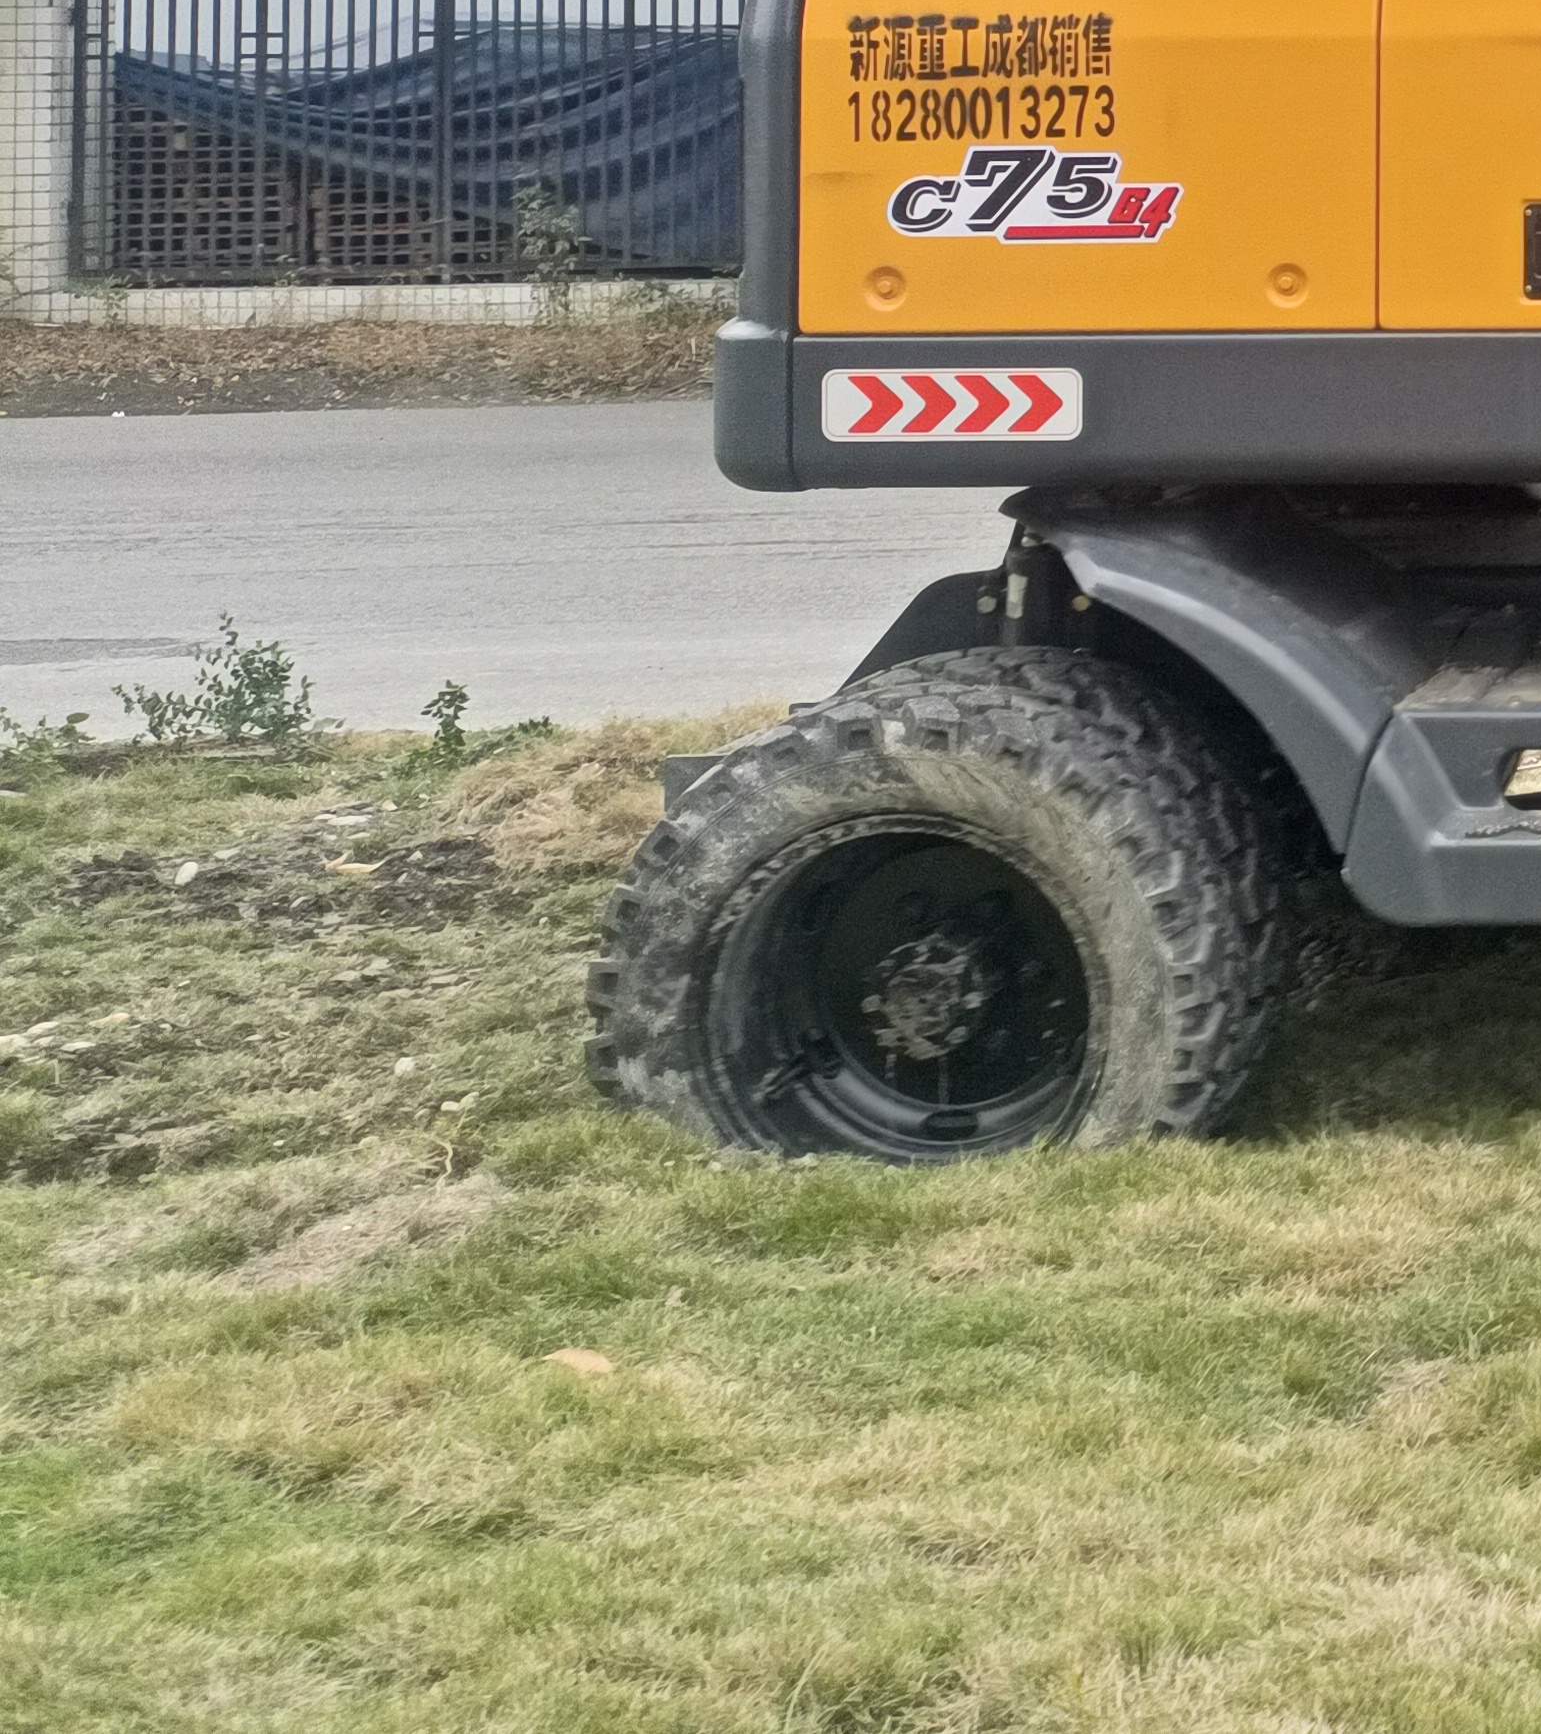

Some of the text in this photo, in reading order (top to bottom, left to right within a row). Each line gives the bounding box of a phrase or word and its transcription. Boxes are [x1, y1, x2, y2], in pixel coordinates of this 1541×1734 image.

[848, 13, 1114, 81] 新源重工成都销售
[848, 85, 1116, 142] 18280013273
